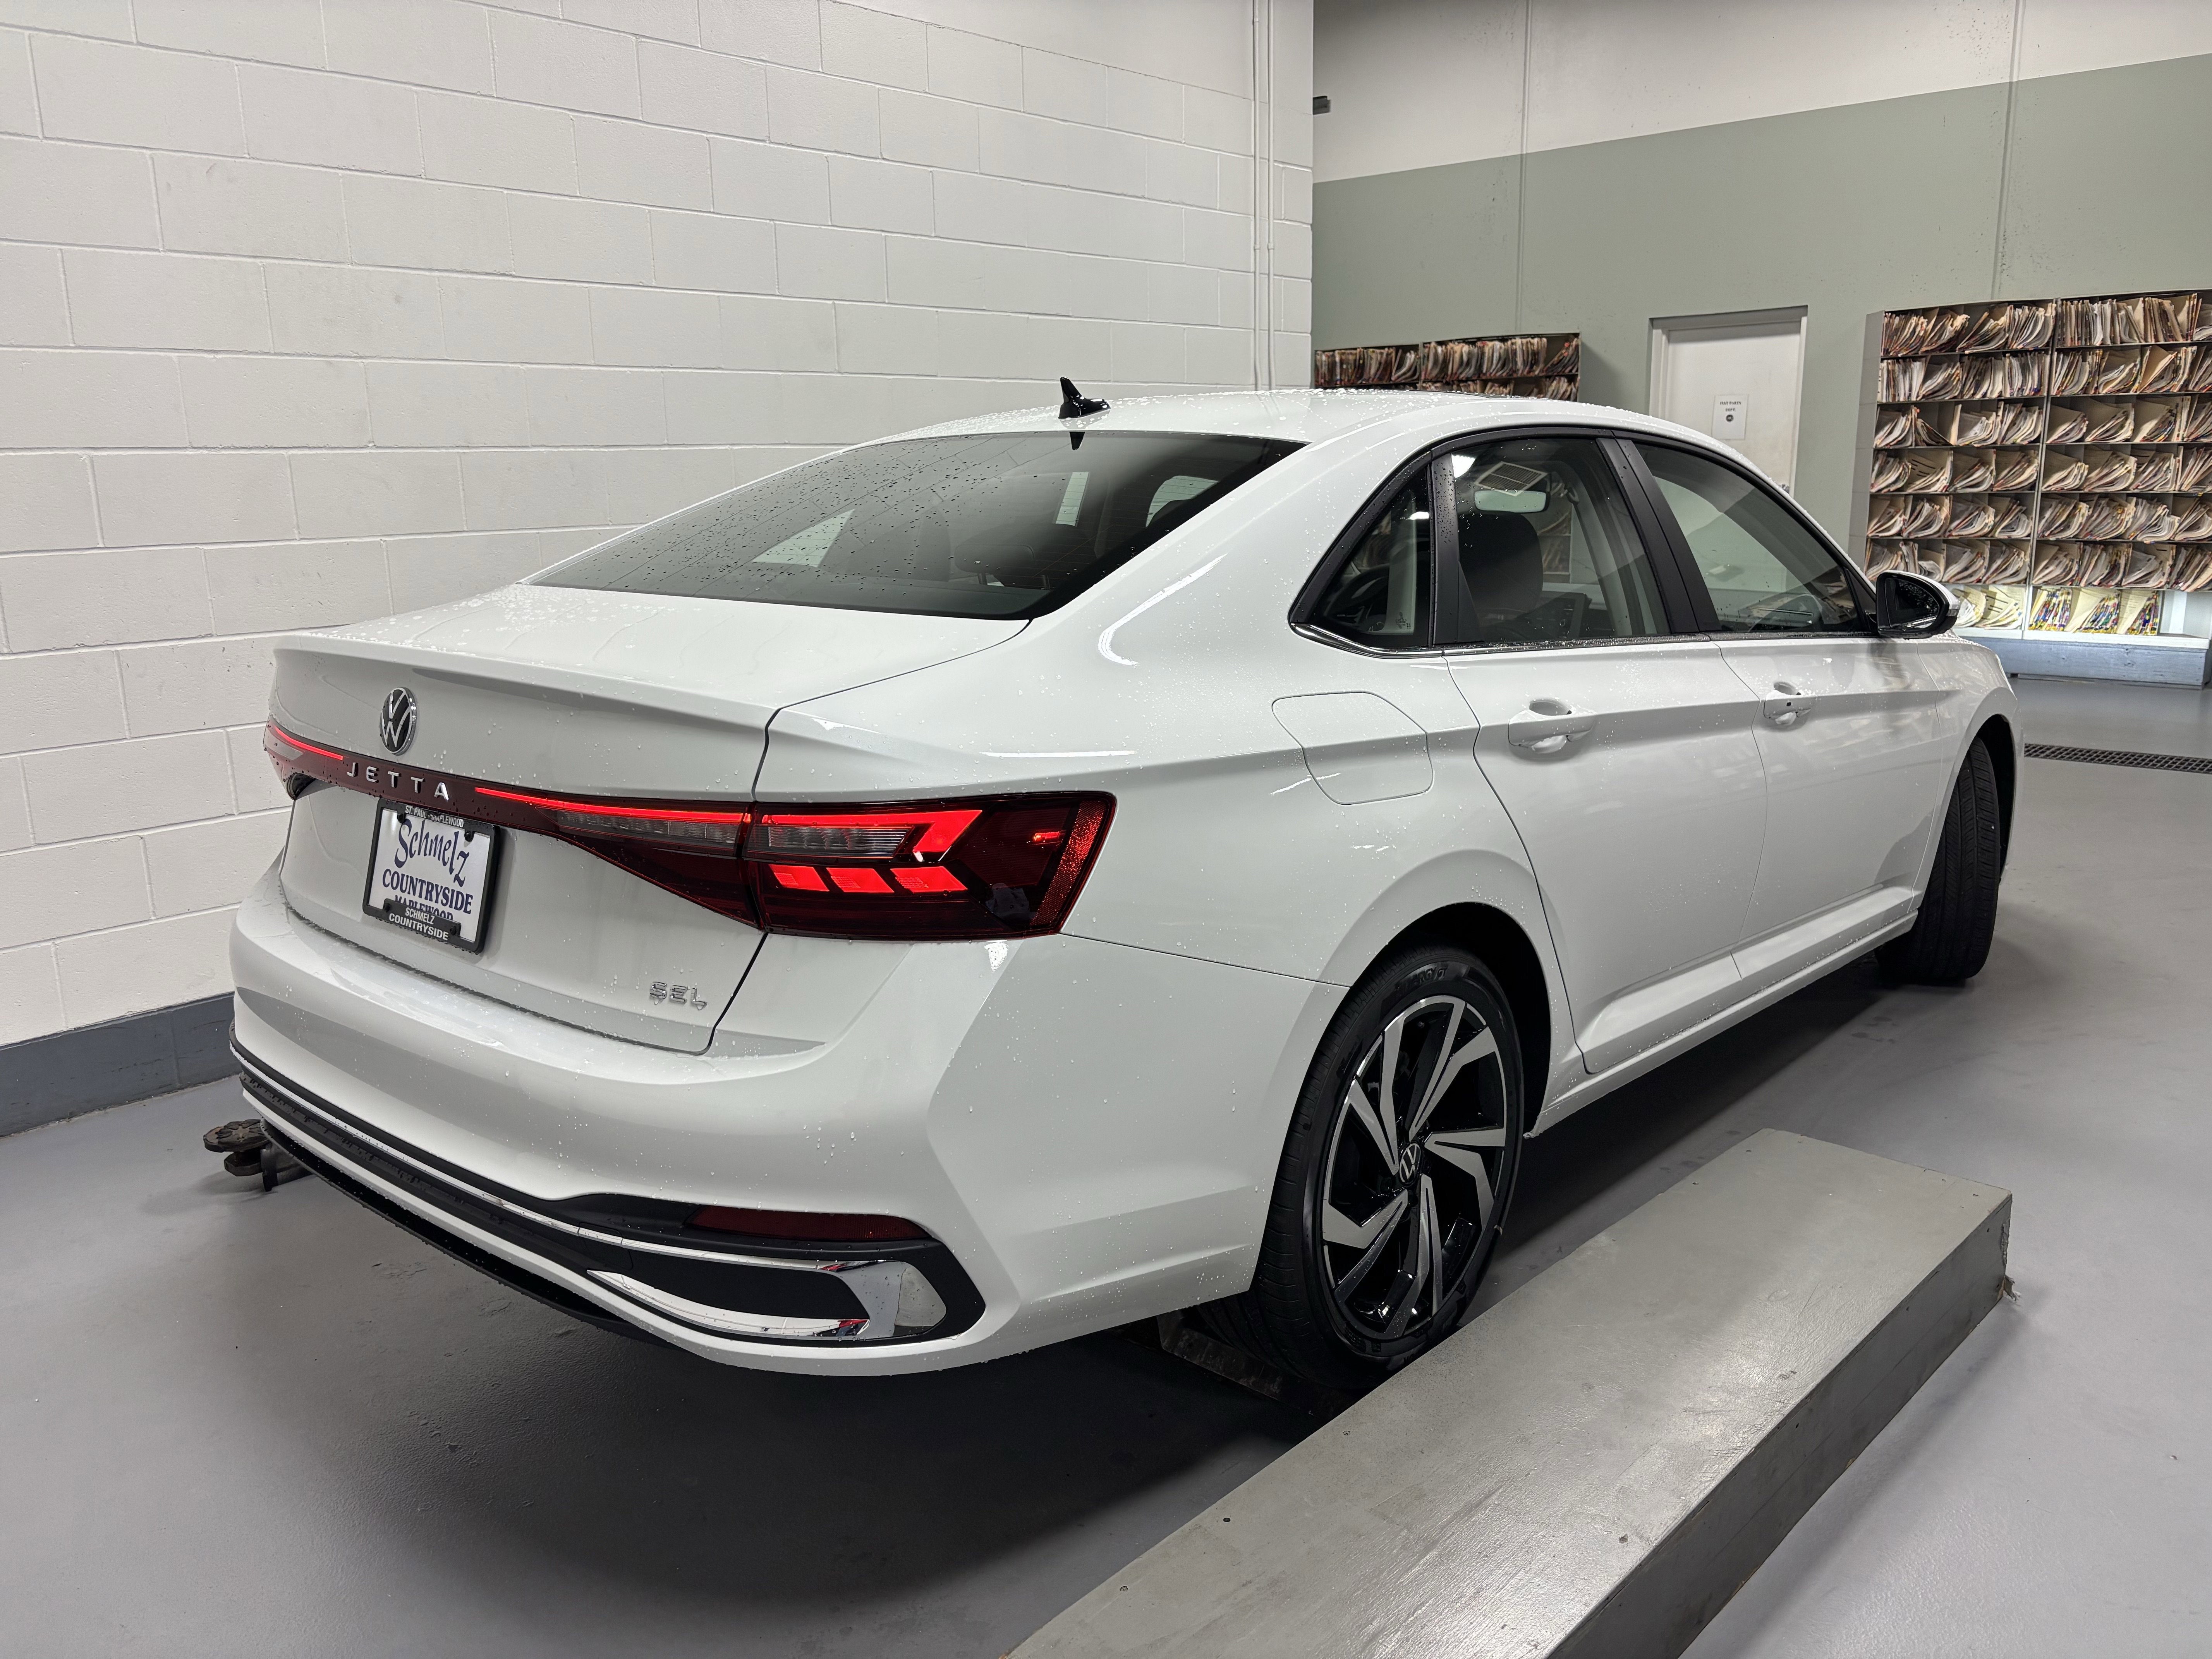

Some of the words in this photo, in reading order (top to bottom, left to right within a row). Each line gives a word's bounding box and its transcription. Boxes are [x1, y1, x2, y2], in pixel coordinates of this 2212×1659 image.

[347, 762, 449, 801] JETTA
[414, 807, 426, 818] PAUL
[394, 818, 470, 887] Schmelz
[383, 868, 473, 914] COUNTRYSIDE
[389, 913, 449, 941] COUNTRYSIDE
[405, 907, 435, 925] SCHMELZ
[649, 981, 708, 1006] SEL
